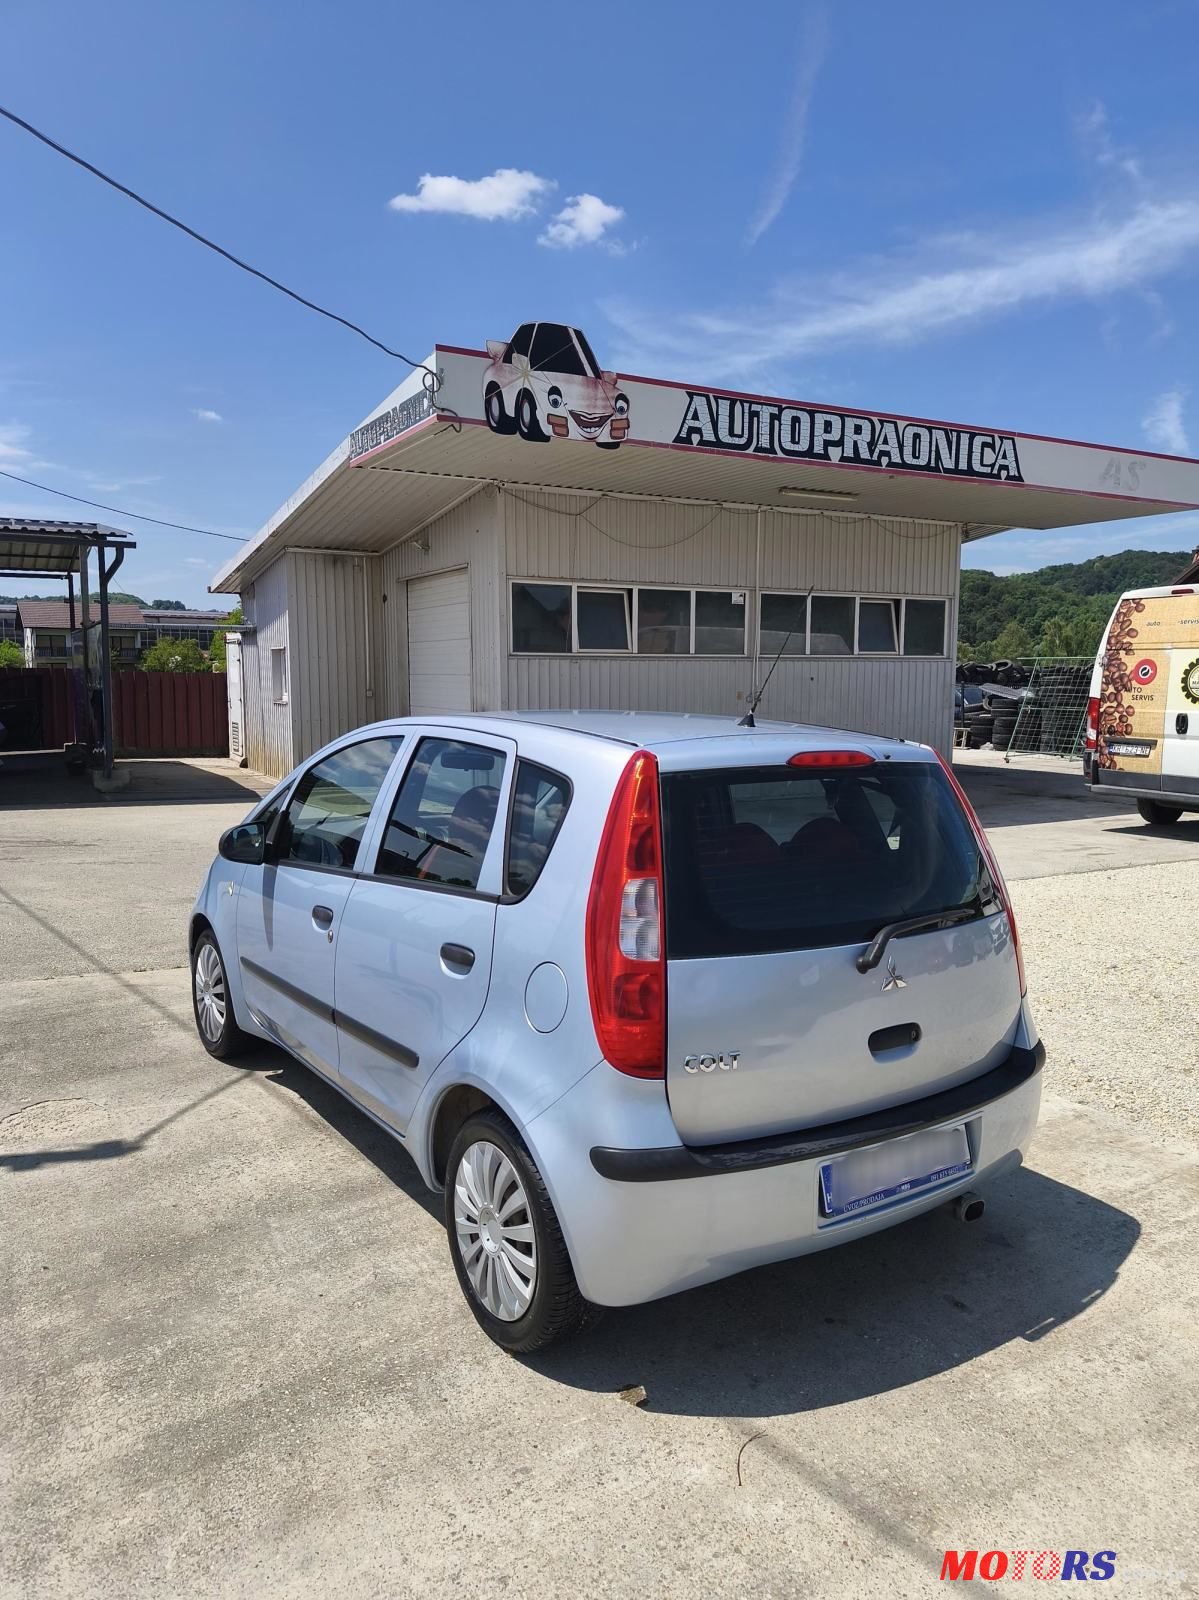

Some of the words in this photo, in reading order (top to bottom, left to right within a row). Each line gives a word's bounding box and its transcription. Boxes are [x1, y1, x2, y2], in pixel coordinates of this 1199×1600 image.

[673, 391, 1025, 483] AUTOPRAONICA
[1100, 457, 1146, 492] AS
[684, 1049, 742, 1074] COLT
